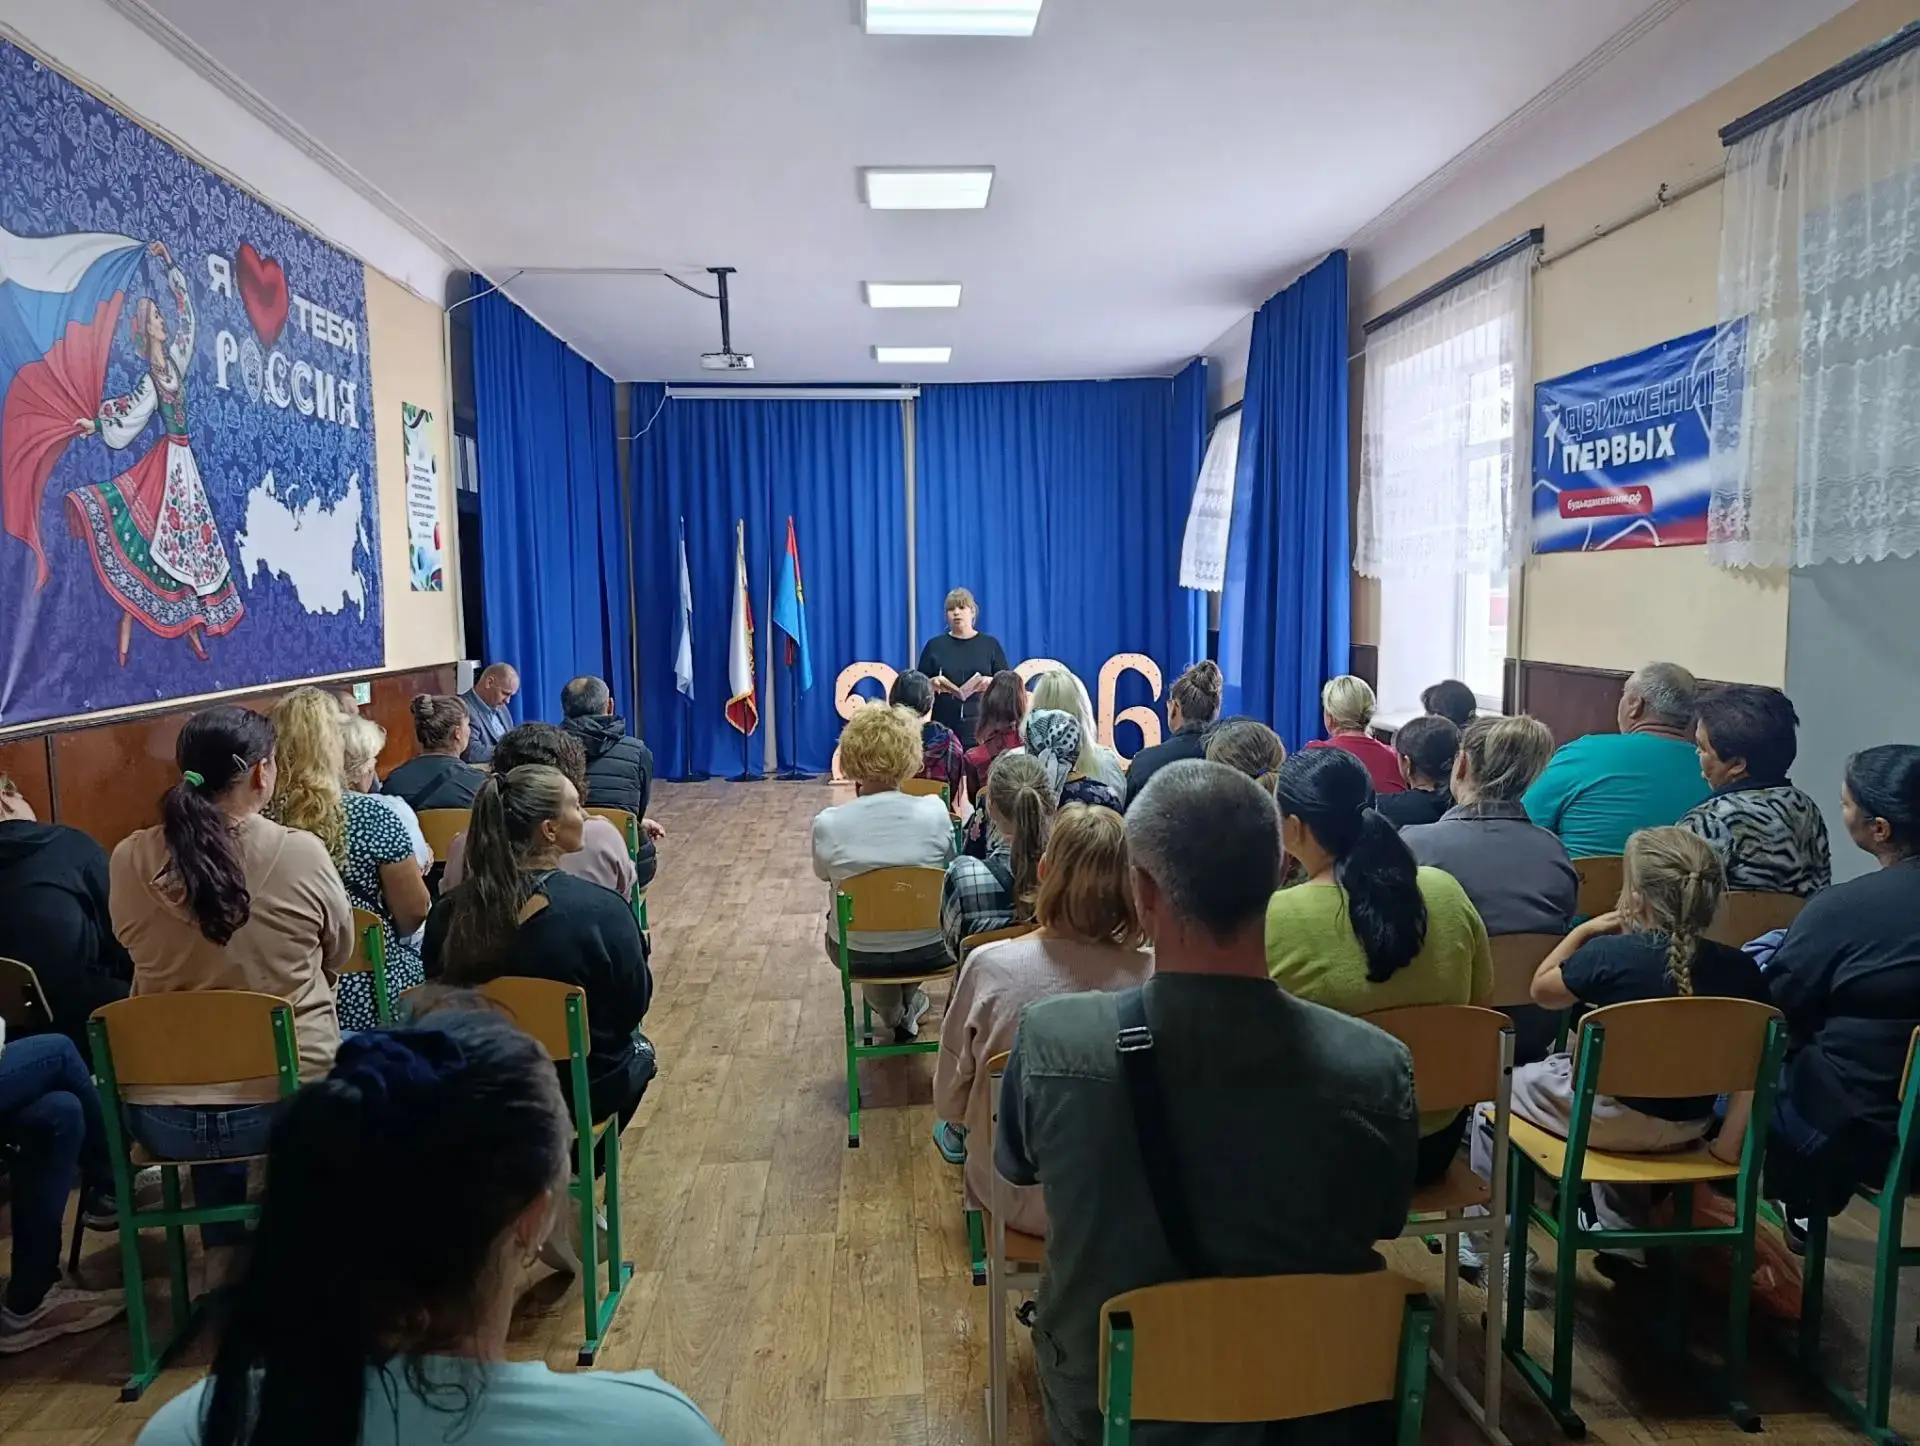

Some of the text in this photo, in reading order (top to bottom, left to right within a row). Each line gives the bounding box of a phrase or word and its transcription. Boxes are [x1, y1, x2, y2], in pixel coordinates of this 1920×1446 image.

[208, 254, 357, 355] Я ТЕБЯ
[215, 330, 359, 429] РОССИЯ
[1563, 368, 1728, 442] ДВИЖЕНИЕ
[1562, 423, 1677, 473] ПЕРВЫХ
